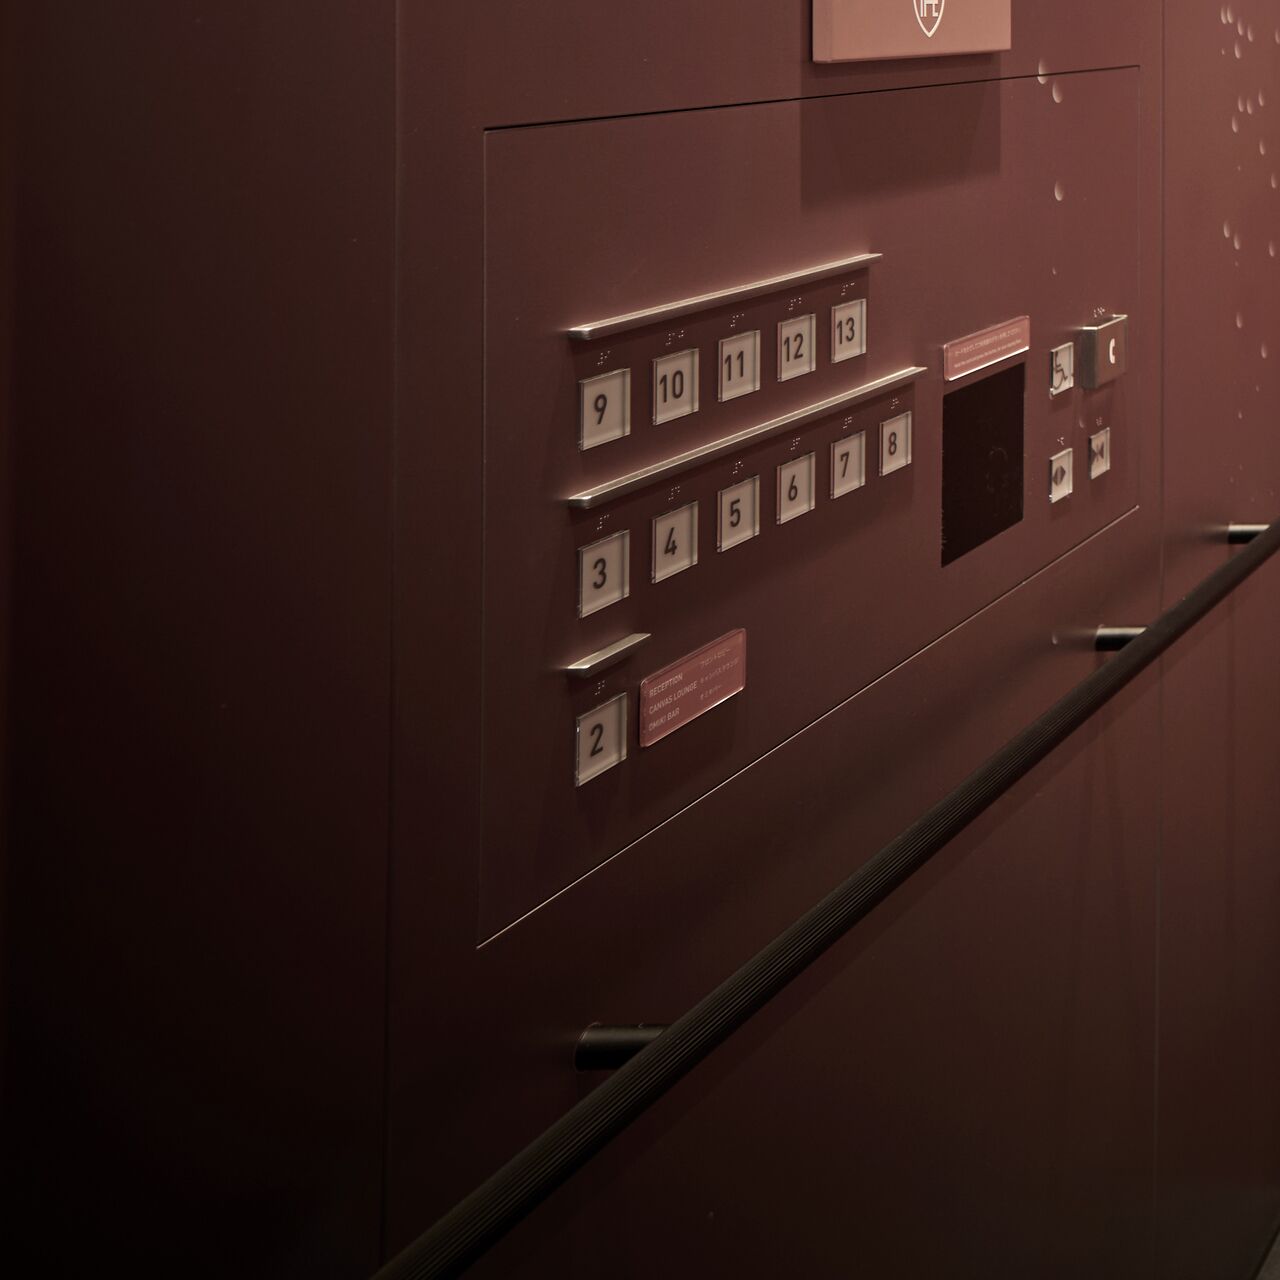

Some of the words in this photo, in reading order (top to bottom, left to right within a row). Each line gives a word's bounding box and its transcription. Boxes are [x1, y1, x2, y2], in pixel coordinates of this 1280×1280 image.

[836, 317, 855, 345] 13
[783, 333, 804, 362] 12
[724, 350, 745, 382] 11
[659, 369, 685, 403] 10
[593, 393, 608, 425] 9
[888, 431, 897, 456] 8
[840, 451, 850, 478] 7
[787, 474, 798, 502] 6
[729, 498, 741, 527] 5
[664, 526, 678, 556] 4
[592, 557, 607, 589] 3
[649, 672, 683, 698] RECEPTION
[673, 680, 698, 701] LOUNGE
[667, 707, 680, 721] BAR
[590, 722, 604, 757] 2
